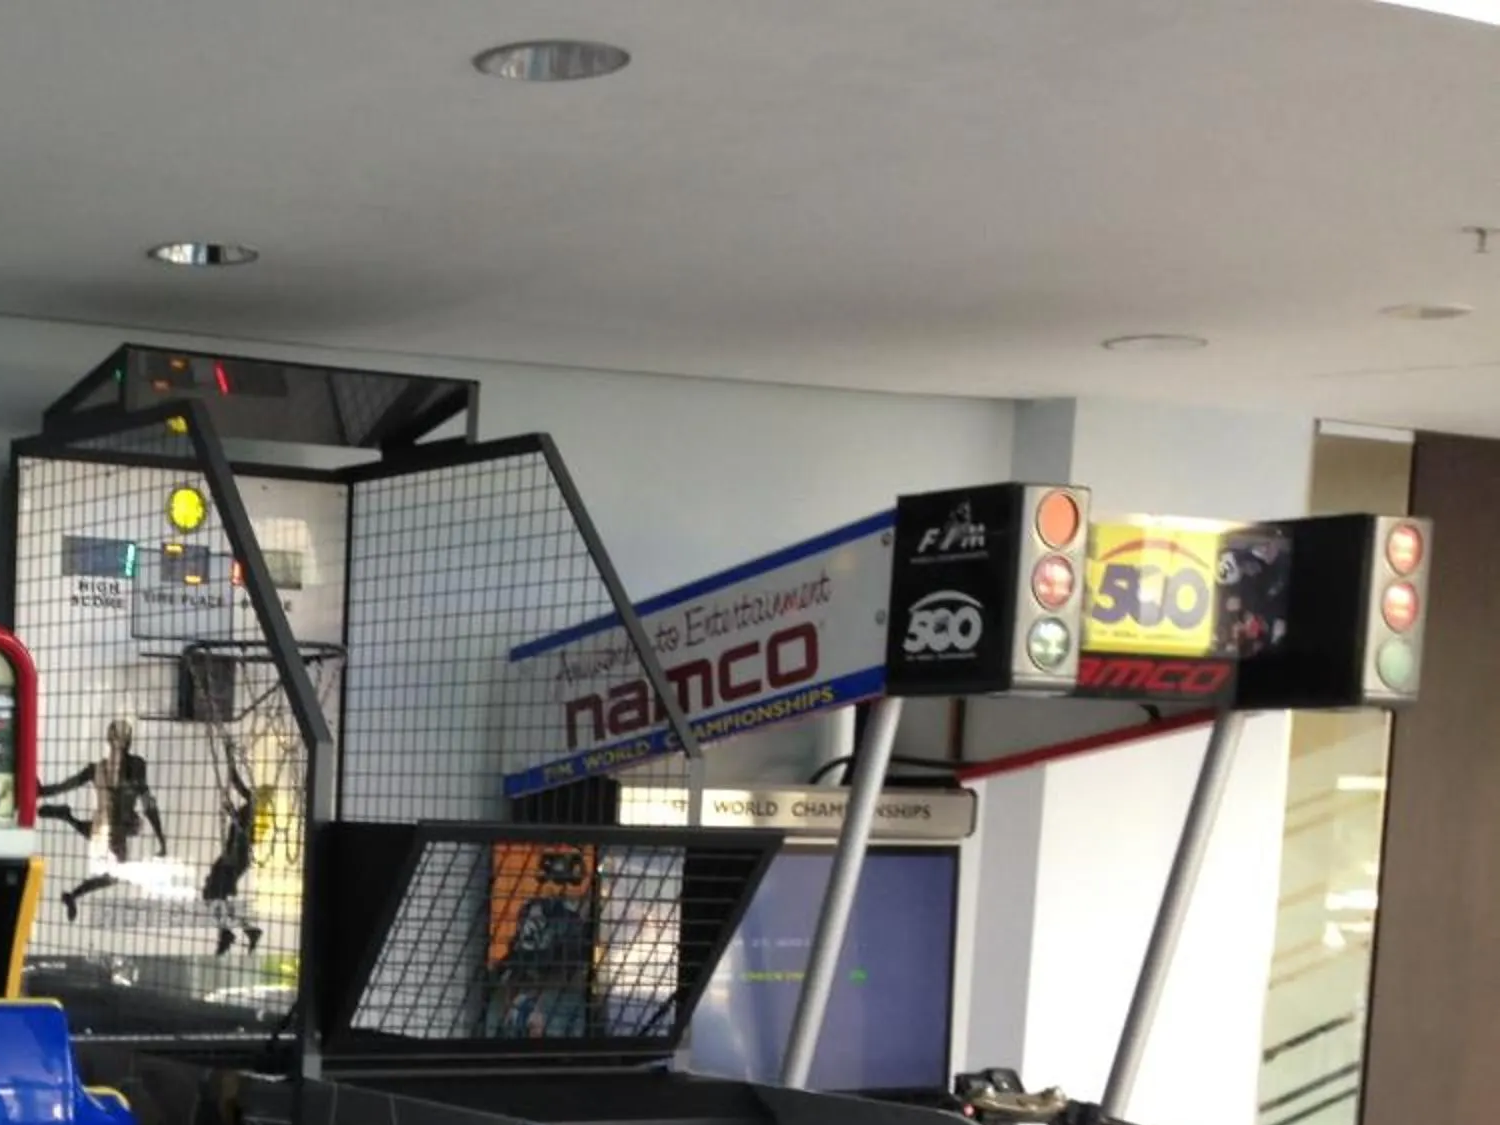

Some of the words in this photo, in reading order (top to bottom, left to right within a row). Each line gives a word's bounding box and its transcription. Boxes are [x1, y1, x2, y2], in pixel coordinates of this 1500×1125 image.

[903, 606, 983, 653] 500
[566, 621, 819, 750] namco
[664, 685, 834, 750] CAMPIONSHIPS
[713, 799, 778, 818] WORLD
[791, 802, 932, 820] CHAMNSHIPS
